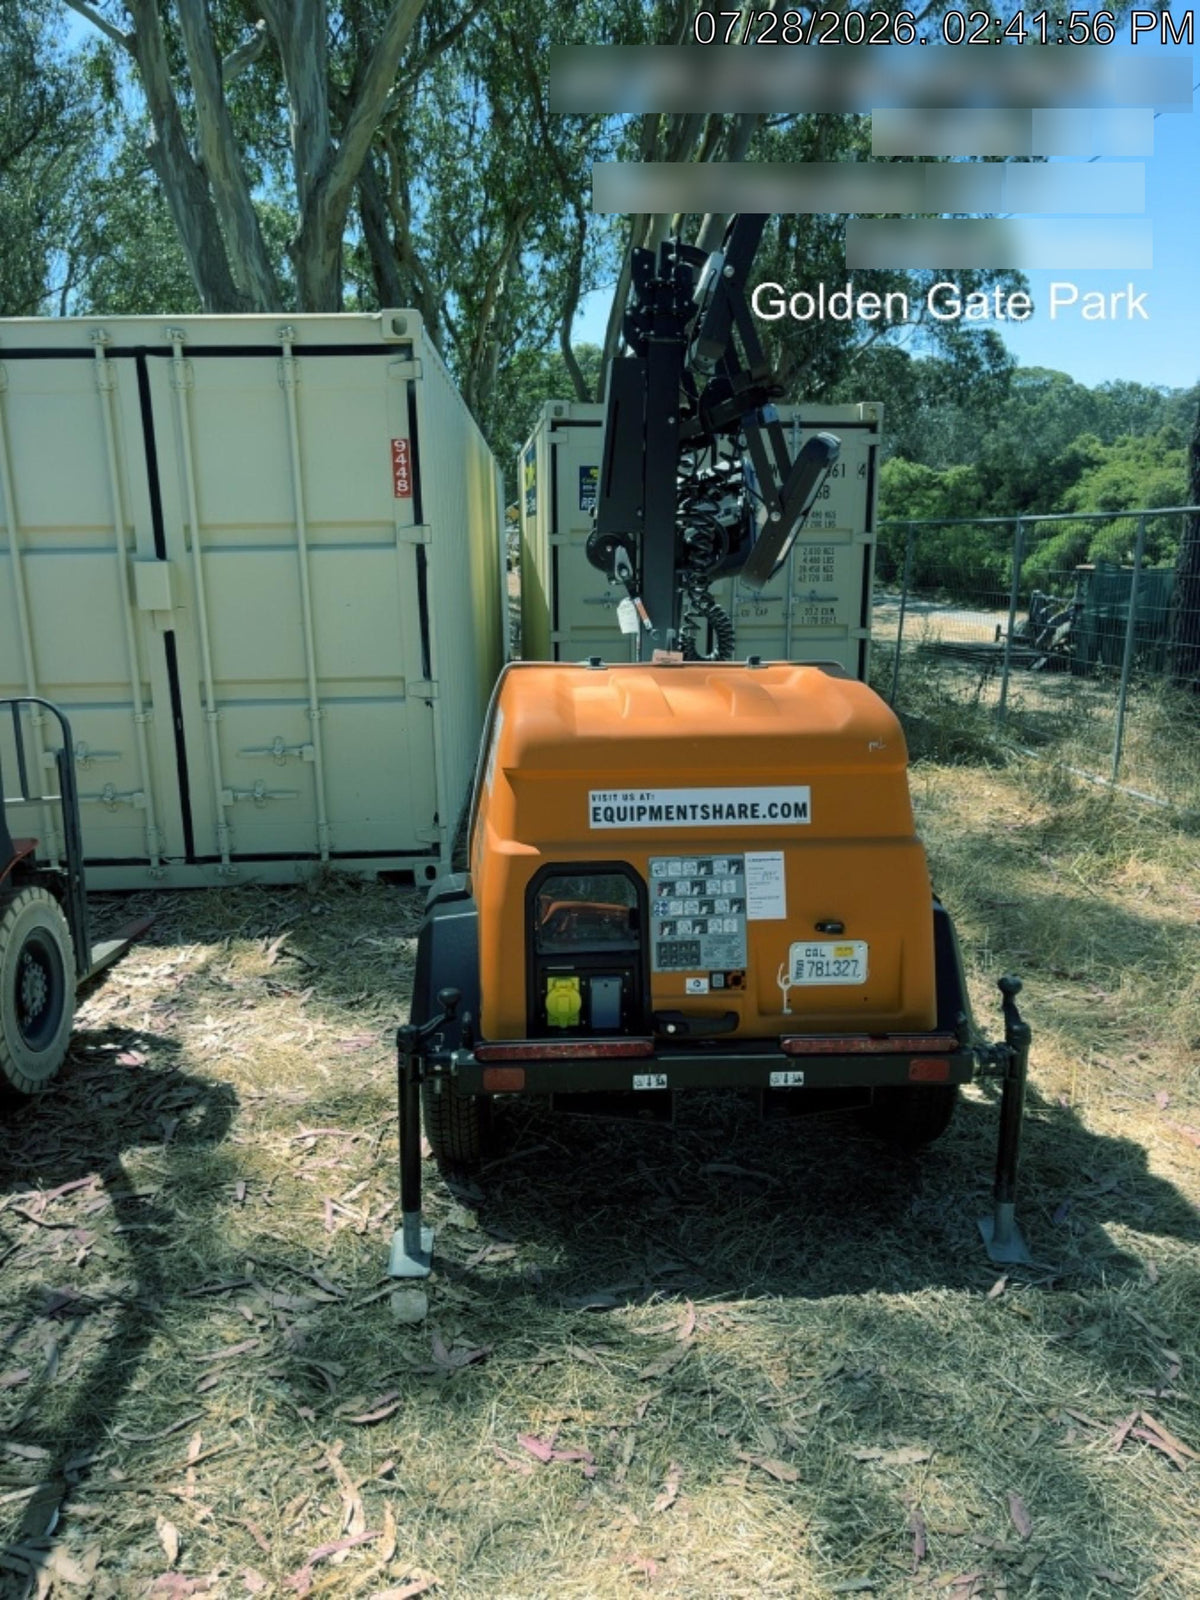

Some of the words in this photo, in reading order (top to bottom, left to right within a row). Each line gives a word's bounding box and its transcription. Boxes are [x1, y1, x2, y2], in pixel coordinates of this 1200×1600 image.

[393, 439, 408, 492] 9448
[591, 793, 618, 802] VISIT
[621, 792, 636, 801] US
[639, 791, 655, 801] AT:
[591, 801, 809, 824] EQUIPMENTSHARE.COM
[805, 947, 826, 958] CAL
[806, 959, 859, 977] 781327
